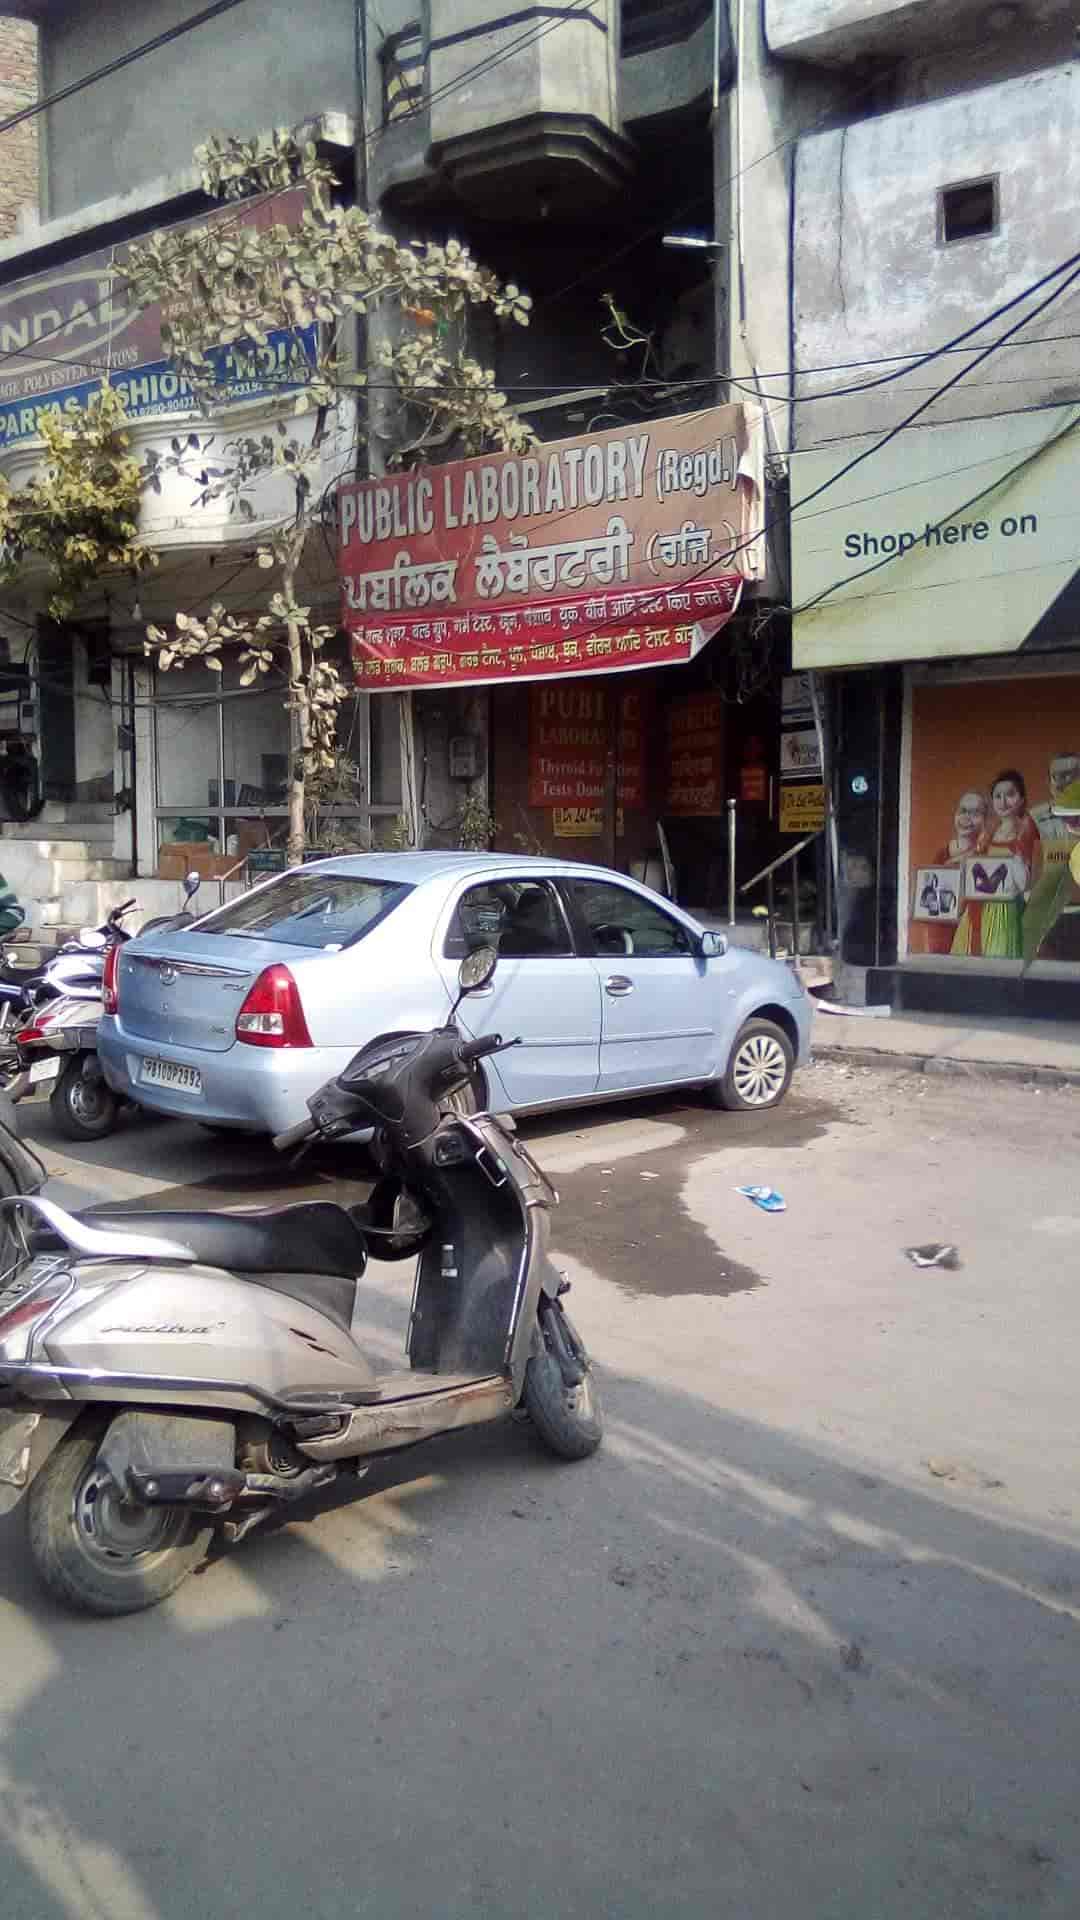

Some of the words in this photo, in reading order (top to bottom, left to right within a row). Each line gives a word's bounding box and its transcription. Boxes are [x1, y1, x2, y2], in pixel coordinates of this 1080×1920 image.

[24, 363, 91, 392] POLYESTER
[341, 478, 433, 546] PUBLIC
[444, 435, 649, 529] LABORATORY
[657, 436, 737, 503] (Regd.)
[845, 531, 916, 558] Shop
[925, 521, 989, 547] here
[1000, 514, 1036, 536] on
